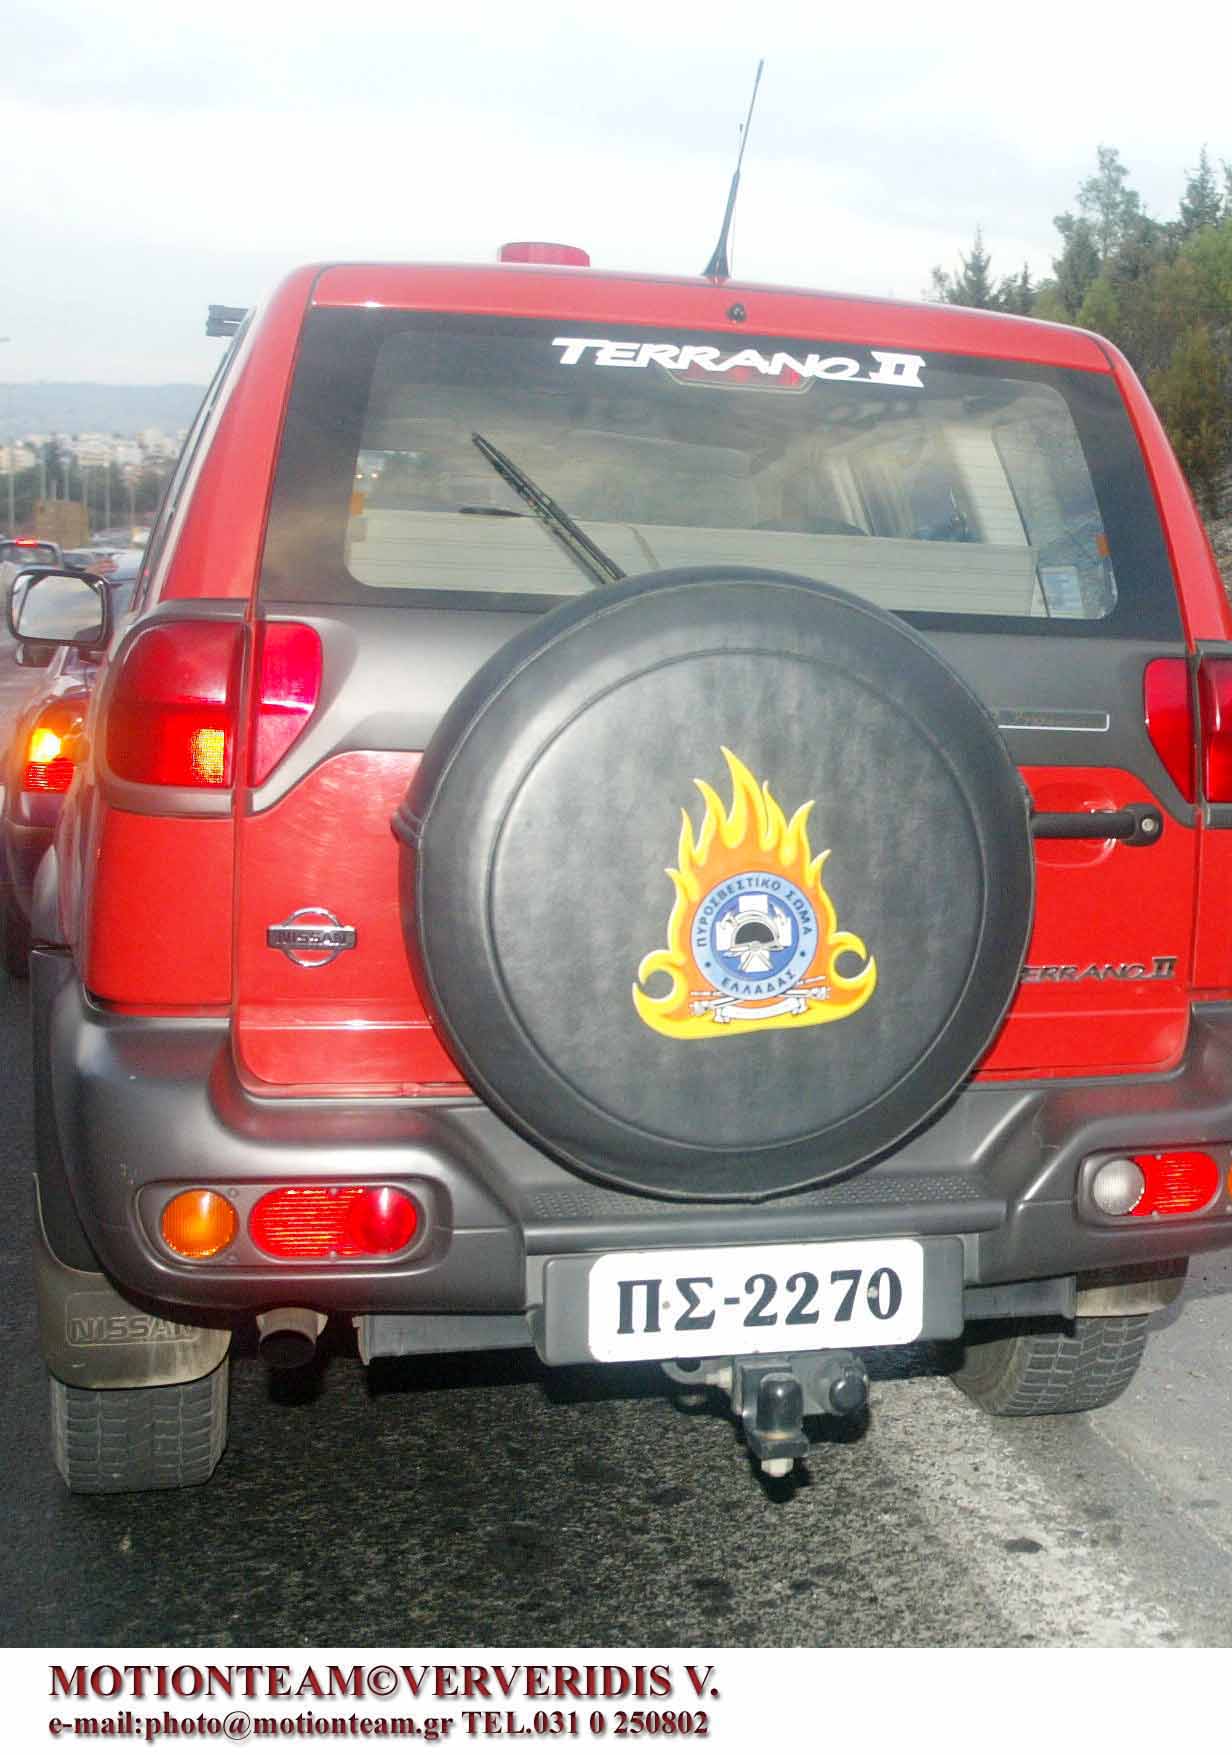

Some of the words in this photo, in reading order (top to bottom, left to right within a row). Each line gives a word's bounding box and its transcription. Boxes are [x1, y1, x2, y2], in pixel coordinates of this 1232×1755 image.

[552, 336, 861, 379] TERRANO
[868, 350, 927, 388] II
[785, 889, 813, 936] ΣΩΜΑ
[721, 970, 796, 996] ΕΛΛΑΔΑΣ
[1020, 963, 1146, 984] ERRANO
[617, 1267, 902, 1334] ΠΣ-2270
